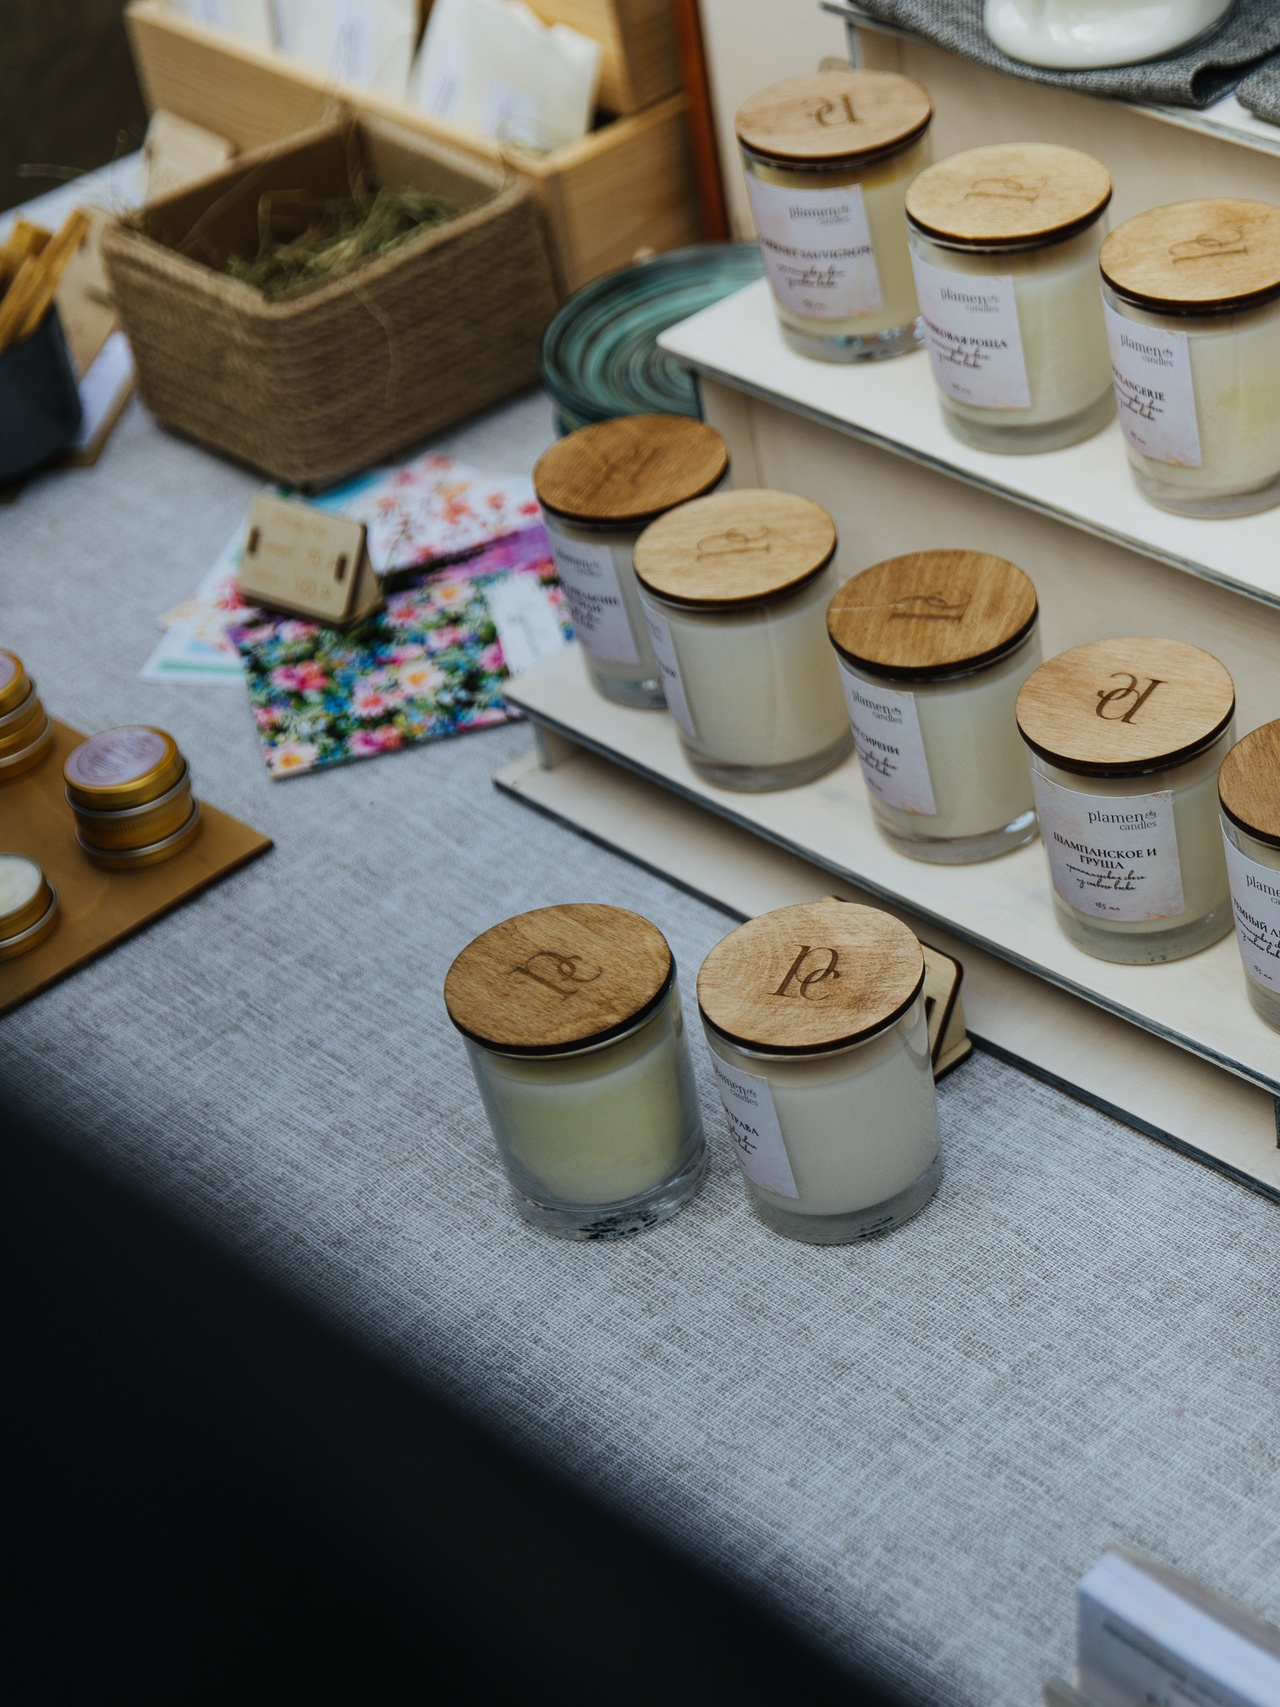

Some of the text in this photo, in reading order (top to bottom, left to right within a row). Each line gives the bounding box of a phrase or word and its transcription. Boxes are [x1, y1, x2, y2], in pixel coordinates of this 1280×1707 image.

[940, 288, 987, 304] plamen
[969, 338, 1008, 350] РОЩА
[1120, 334, 1162, 358] plamen
[1141, 355, 1174, 368] candles
[851, 690, 891, 715] plamen
[872, 711, 903, 724] candles
[860, 731, 901, 756] СИРЕНИ
[1087, 810, 1145, 824] plamen
[1119, 820, 1157, 831] candles
[1053, 831, 1157, 859] ШАМПАНСКОЕ И
[1079, 855, 1125, 870] ГРУША
